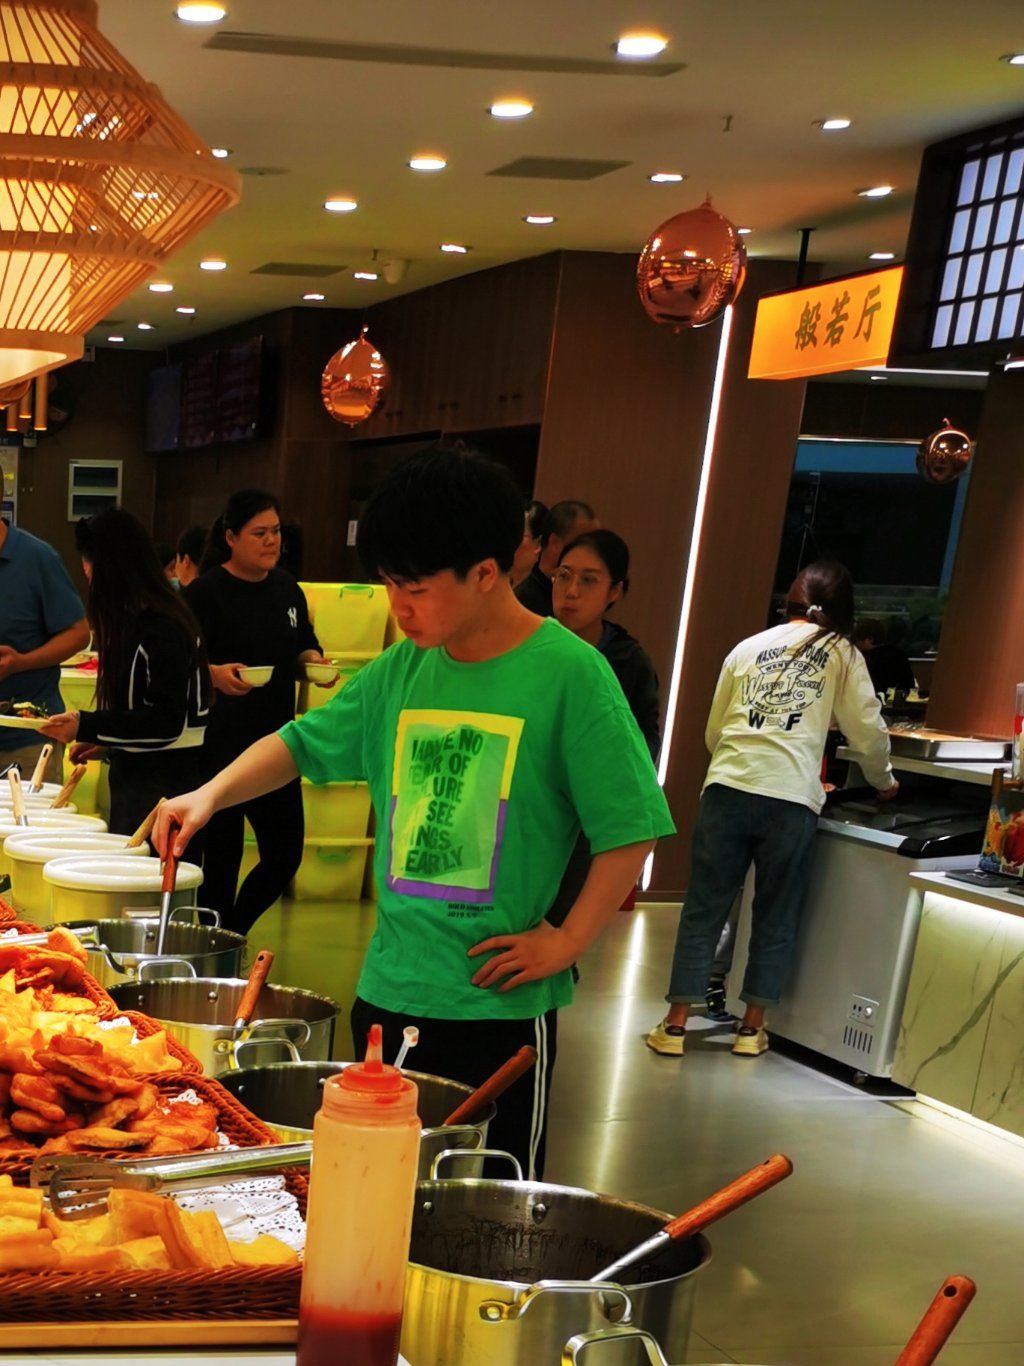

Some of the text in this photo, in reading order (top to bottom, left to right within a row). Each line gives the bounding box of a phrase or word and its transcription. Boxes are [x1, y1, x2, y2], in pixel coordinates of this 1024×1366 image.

[794, 284, 882, 351] 般若厅
[459, 728, 484, 756] NO
[449, 752, 471, 777] OF
[426, 799, 456, 827] SEE
[405, 845, 463, 874] EARLY
